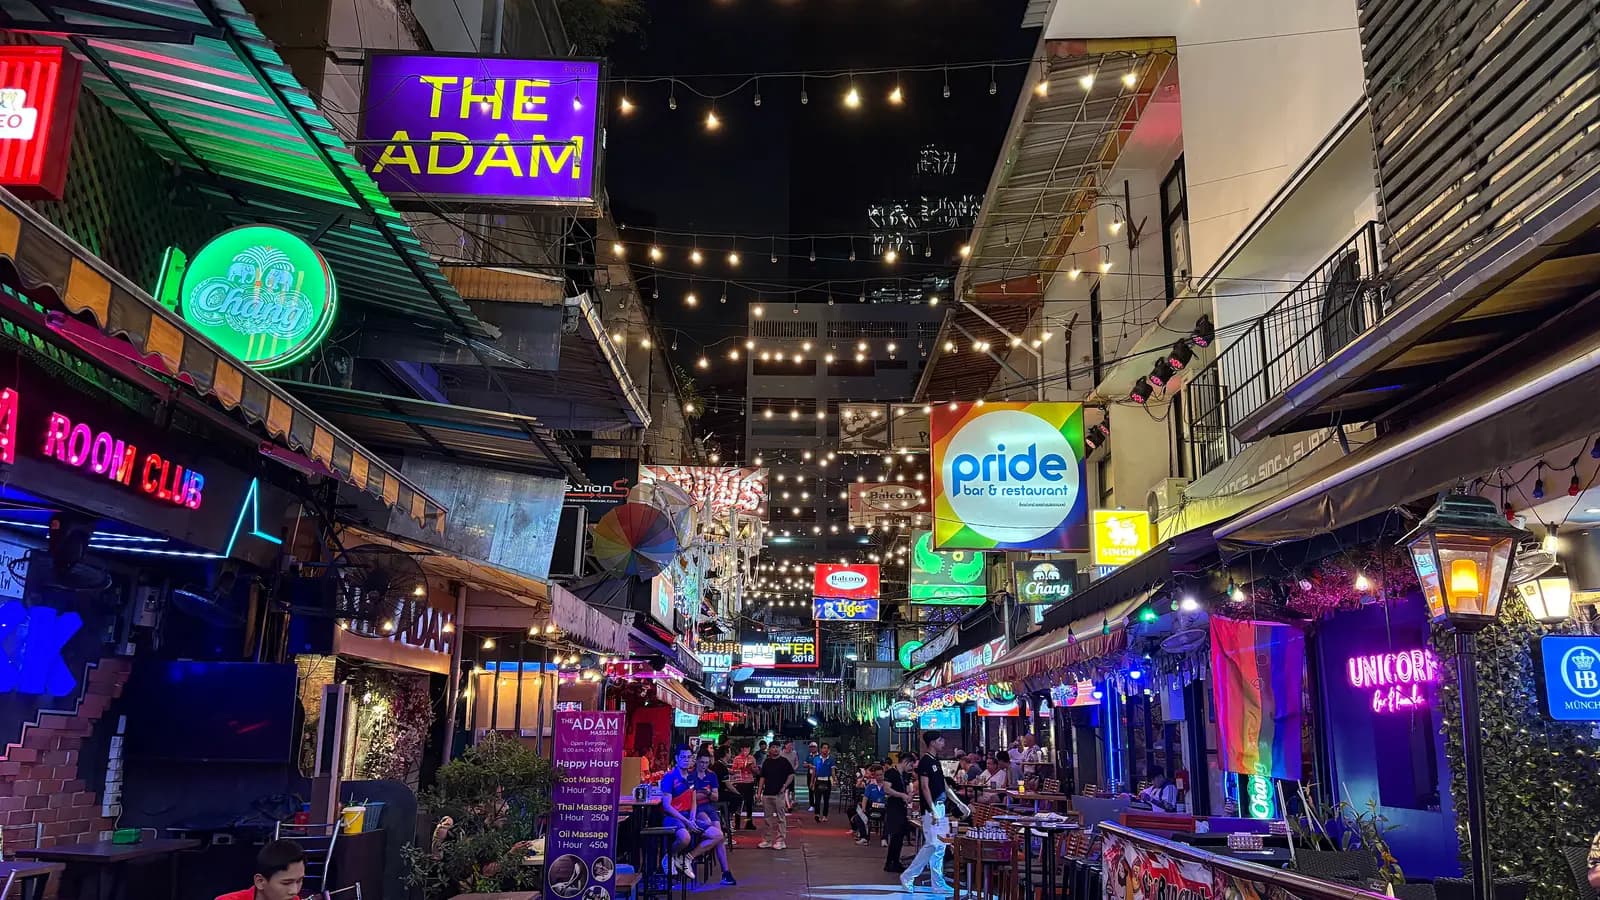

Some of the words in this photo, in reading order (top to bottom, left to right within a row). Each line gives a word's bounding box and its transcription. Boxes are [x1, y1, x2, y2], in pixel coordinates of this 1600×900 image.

[419, 75, 550, 121] THE
[372, 130, 584, 179] ADAM
[199, 283, 305, 328] Chang
[44, 411, 136, 486] ROOM
[142, 453, 205, 510] CLUB
[952, 443, 1067, 497] pride
[869, 491, 919, 501] Balcony
[963, 485, 984, 496] bar
[989, 485, 997, 496] &
[1002, 485, 1068, 496] restaurant
[1103, 547, 1142, 557] SINGHA
[831, 575, 865, 583] Balcony
[1025, 582, 1070, 596] Chang
[836, 601, 868, 617] Tiger
[791, 654, 815, 663] 2018
[1574, 670, 1598, 689] HB
[572, 718, 618, 730] ADAM
[556, 760, 587, 769] Happy
[589, 760, 619, 768] Hours
[579, 776, 615, 784] Massage
[1251, 763, 1269, 818] Chang
[558, 803, 574, 811] Thai
[565, 813, 584, 821] Hour
